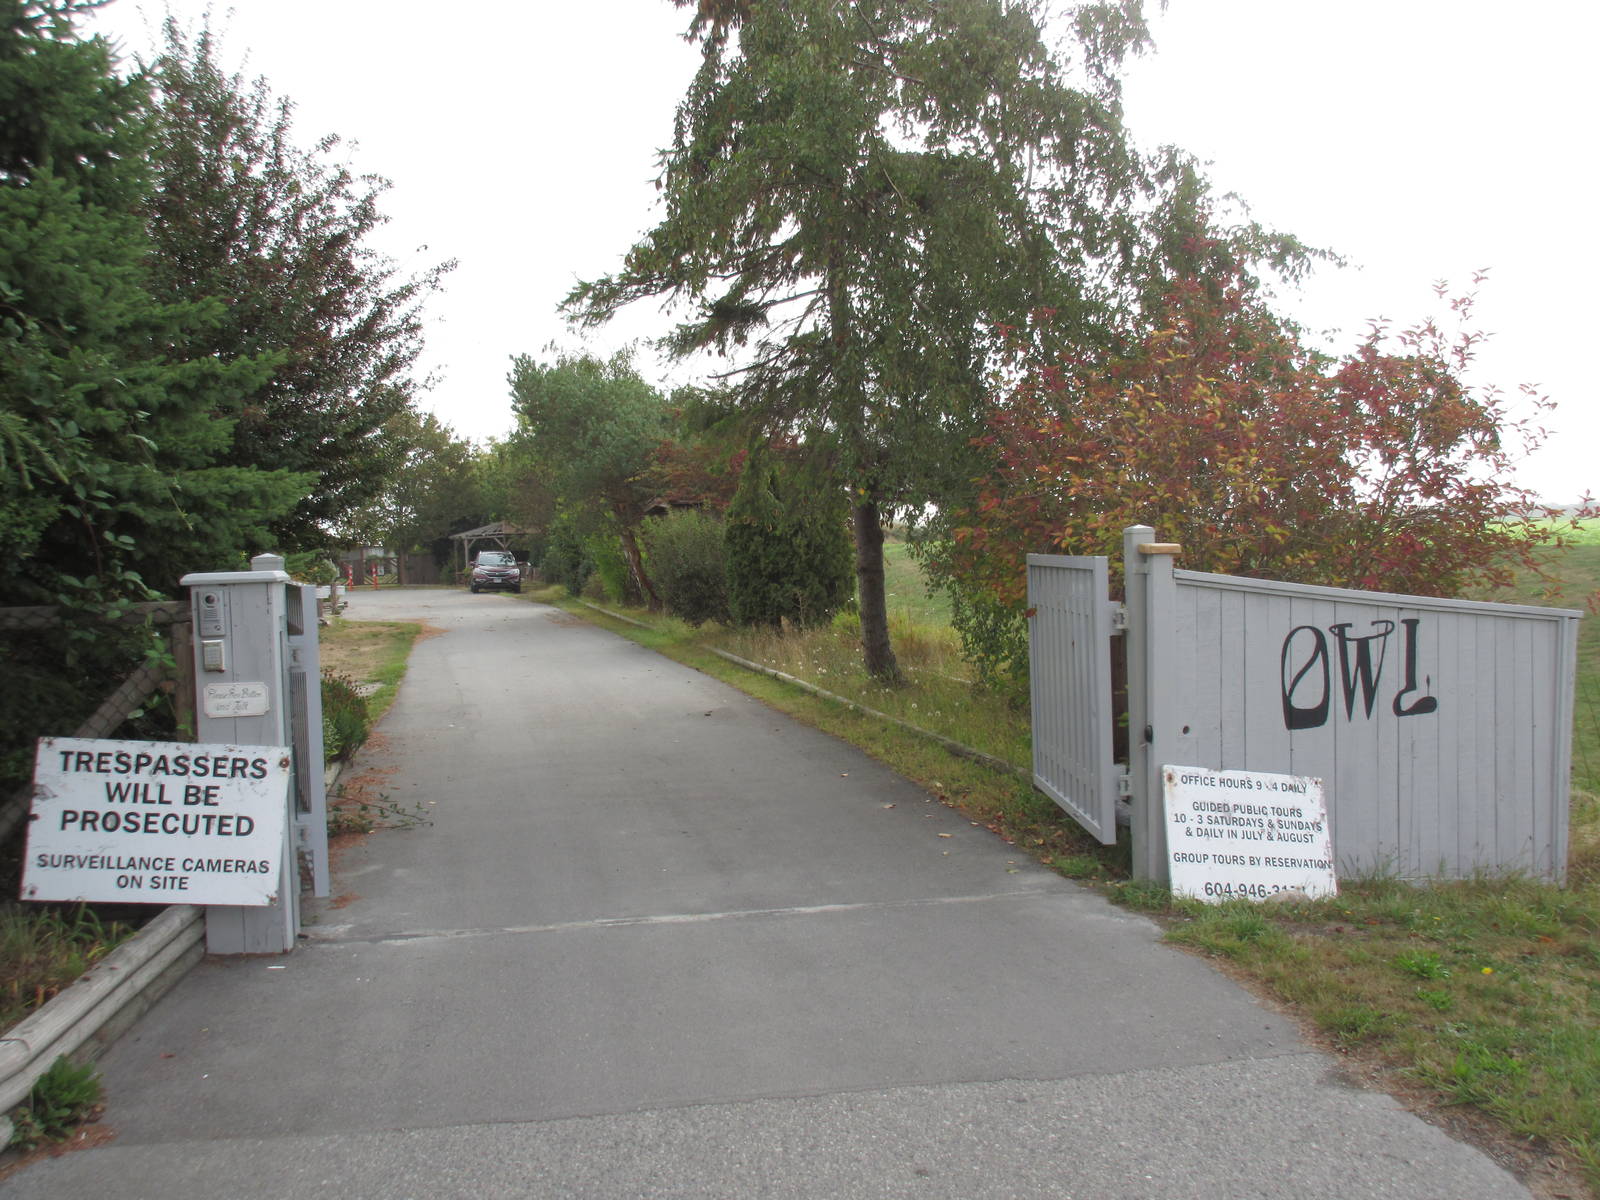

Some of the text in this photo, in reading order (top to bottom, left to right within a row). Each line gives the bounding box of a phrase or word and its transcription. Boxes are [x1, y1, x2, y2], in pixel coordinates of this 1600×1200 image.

[1281, 618, 1437, 730] OWL
[60, 750, 268, 779] TRESPASSERS
[105, 782, 220, 806] WILL BE
[1180, 774, 1216, 787] OFFICE
[1219, 778, 1253, 790] HOURS
[1256, 780, 1262, 790] 9
[1272, 782, 1278, 791] 4
[1281, 782, 1307, 794] DAILY
[1192, 801, 1303, 818] GUIDED PUBLIC TOURS
[60, 810, 255, 837] PROSECUTED
[1174, 813, 1187, 823] 10
[1197, 815, 1204, 824] 3
[1207, 815, 1264, 829] SATURDAYS
[1267, 819, 1275, 829] &
[1277, 820, 1323, 832] SUNDAYS
[1185, 826, 1314, 844] & DAILY IN JULY & AUGUST
[36, 853, 270, 874] SURVEILLANCE CAMERAS
[1173, 852, 1332, 869] GROUP TOURS BY RESERVATION
[117, 875, 189, 890] ON SITE
